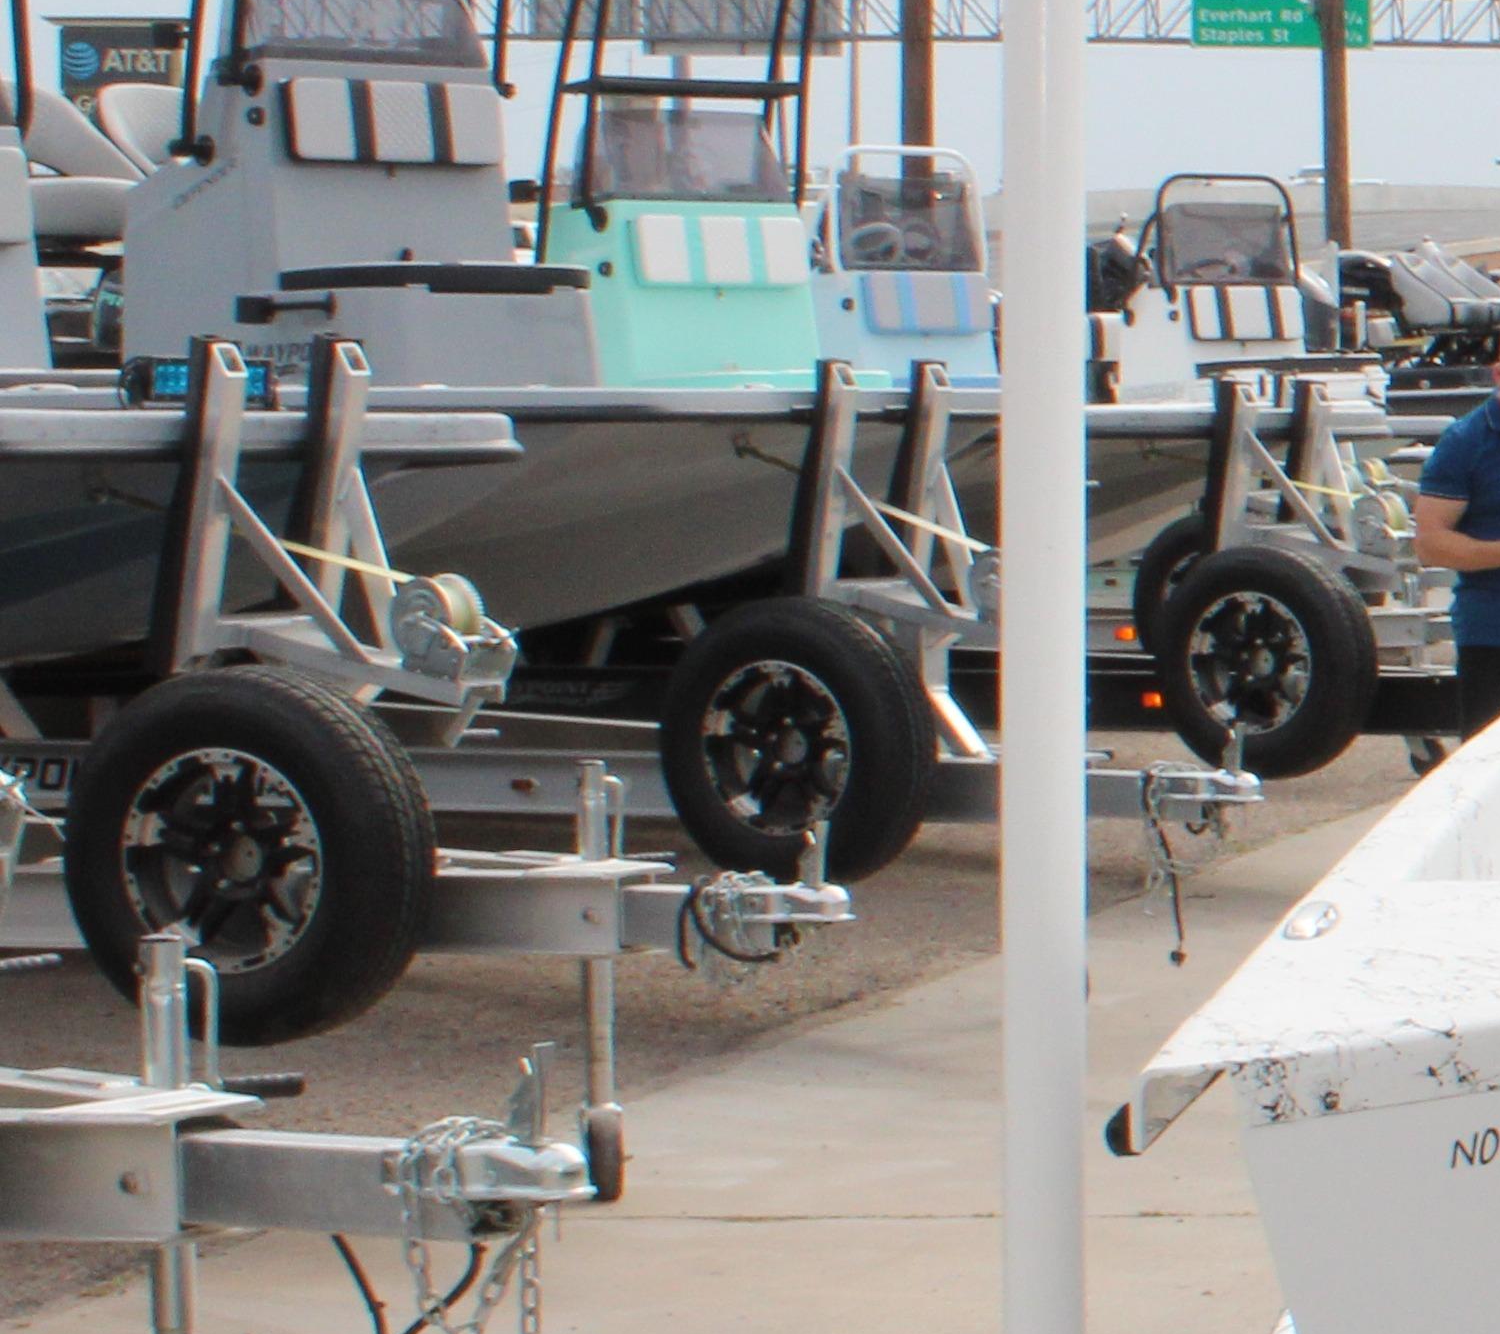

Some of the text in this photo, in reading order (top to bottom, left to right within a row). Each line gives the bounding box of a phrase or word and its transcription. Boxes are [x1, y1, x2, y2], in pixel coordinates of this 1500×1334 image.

[1280, 9, 1304, 23] Rd
[1201, 28, 1264, 44] Staples
[1272, 28, 1289, 42] St
[103, 48, 171, 74] AT&T
[1450, 1127, 1500, 1168] NO
